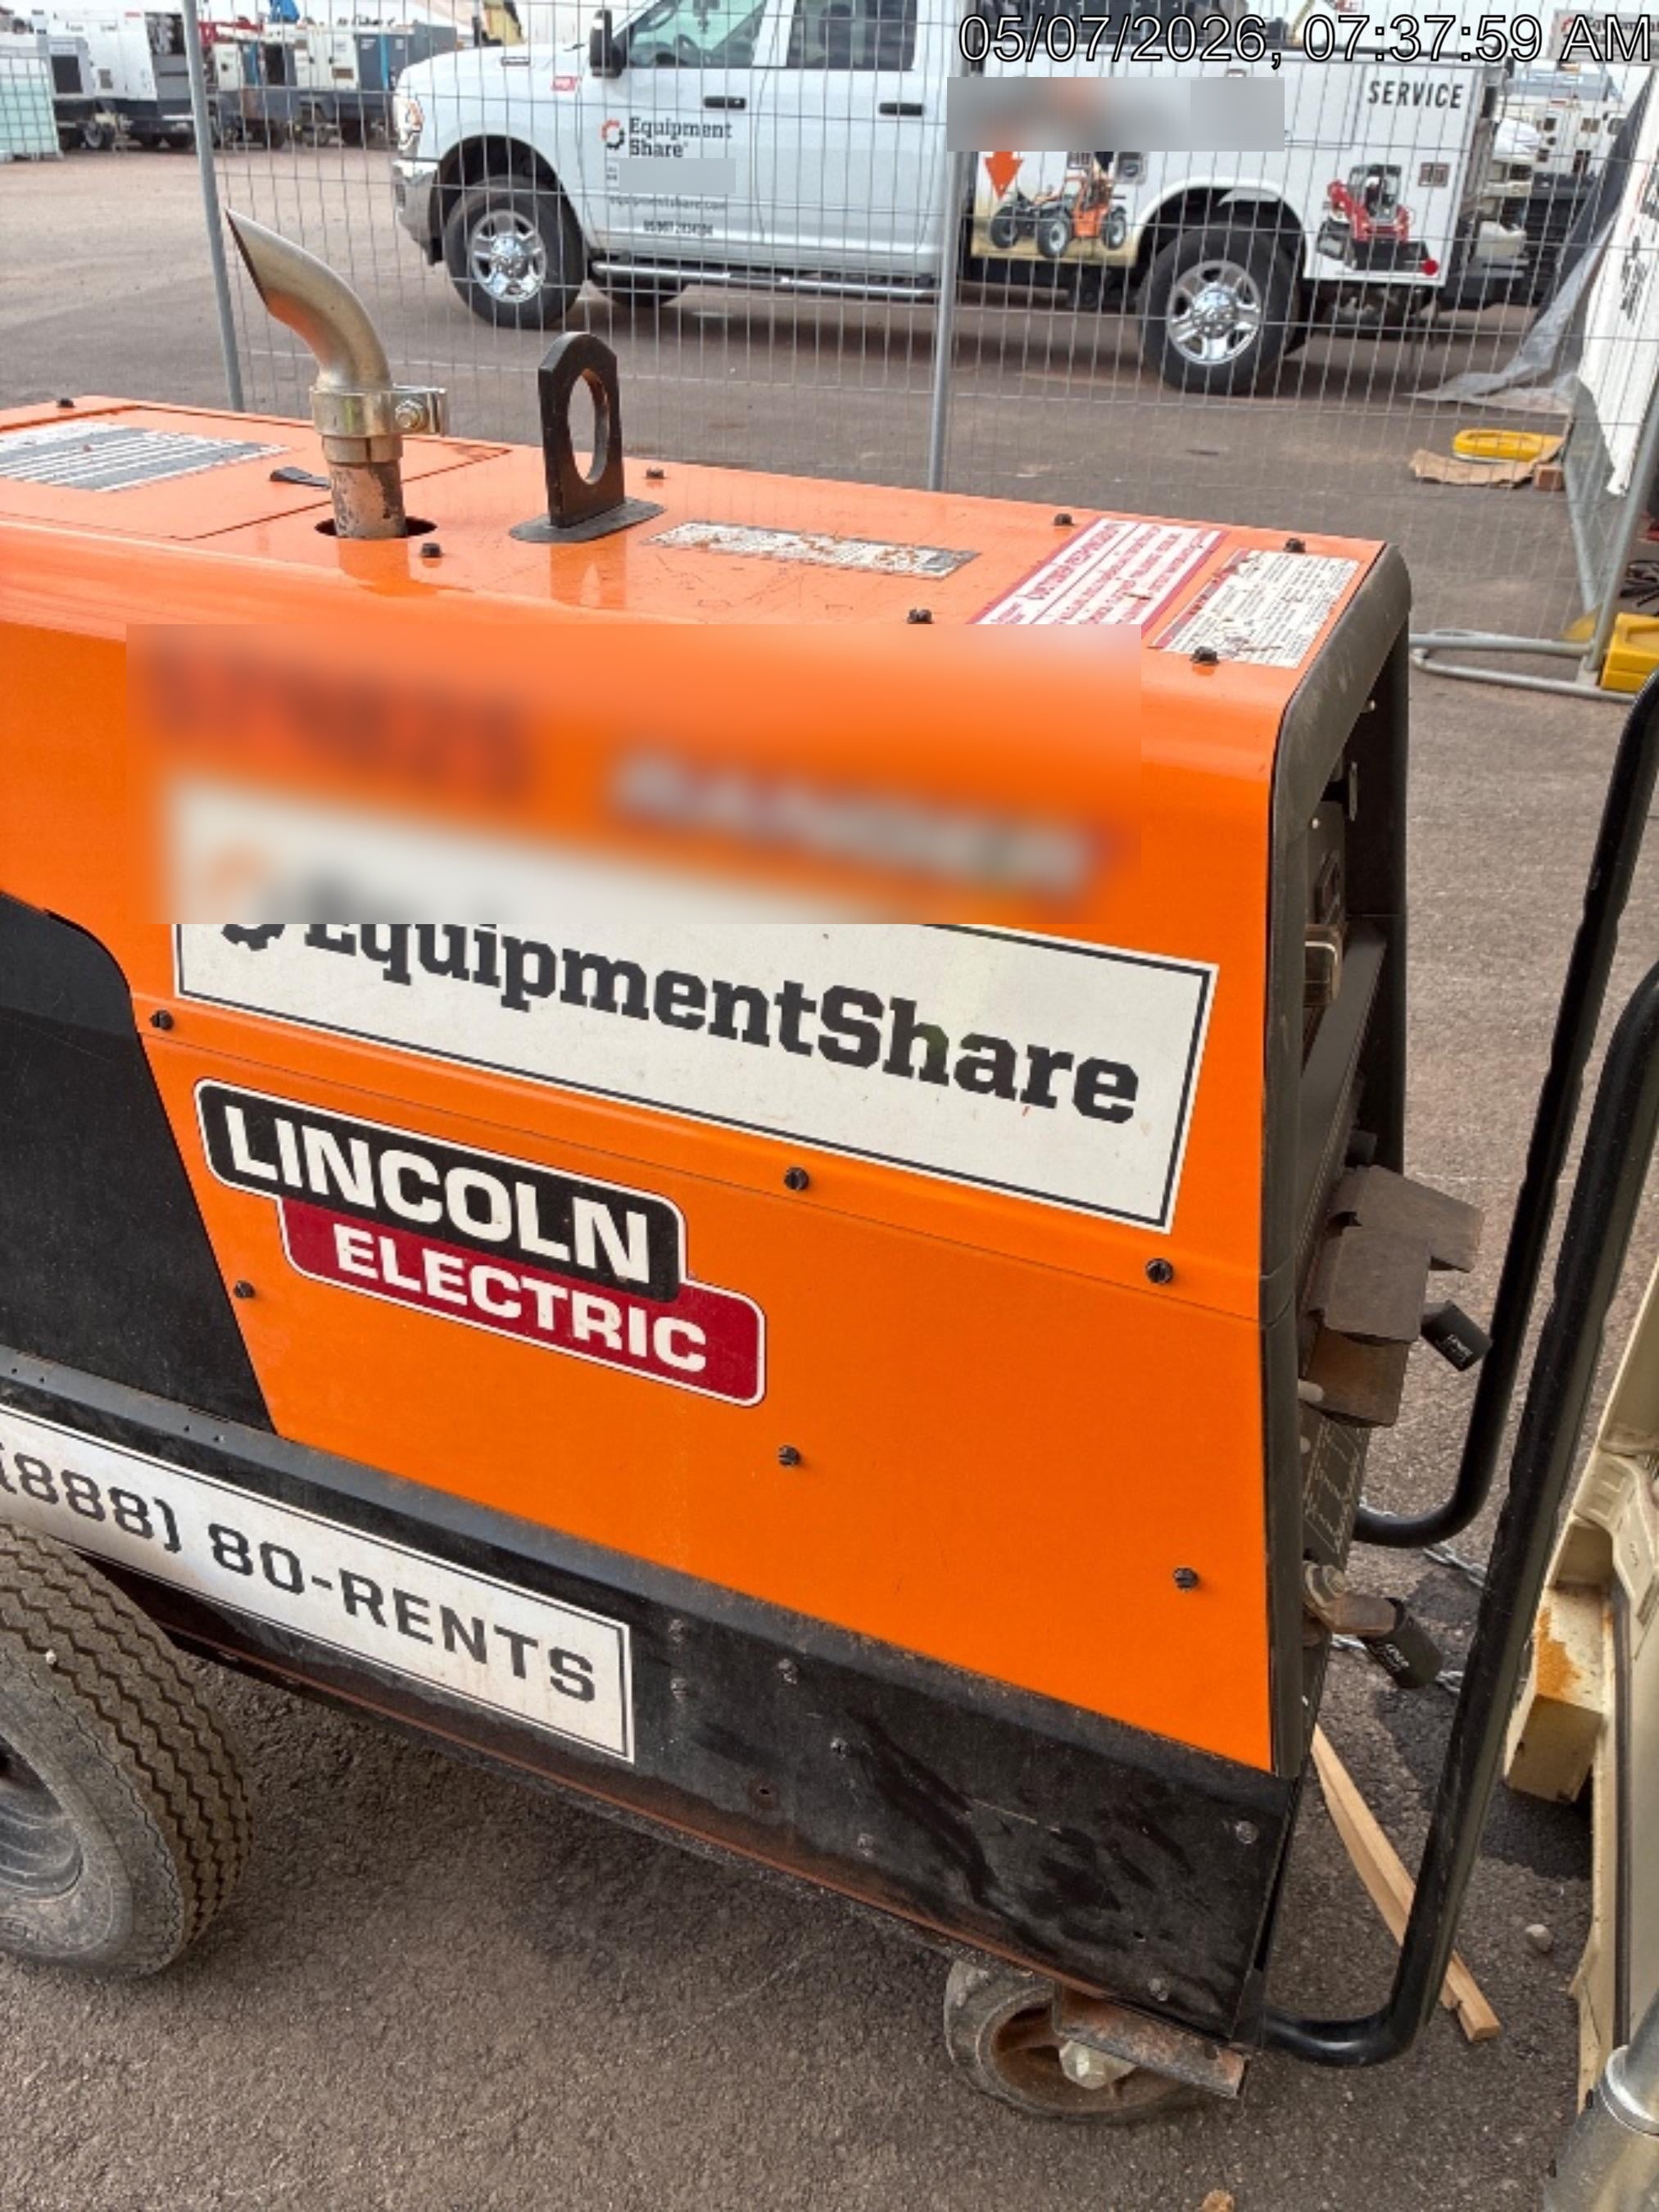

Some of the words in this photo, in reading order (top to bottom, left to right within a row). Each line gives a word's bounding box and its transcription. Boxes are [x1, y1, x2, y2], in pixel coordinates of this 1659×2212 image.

[628, 116, 733, 140] Equipment
[1367, 79, 1465, 109] SERVICE
[224, 1106, 651, 1285] LINCOLN
[332, 1222, 707, 1373] ELECTRIC
[208, 1521, 596, 1702] 80-RENTS
